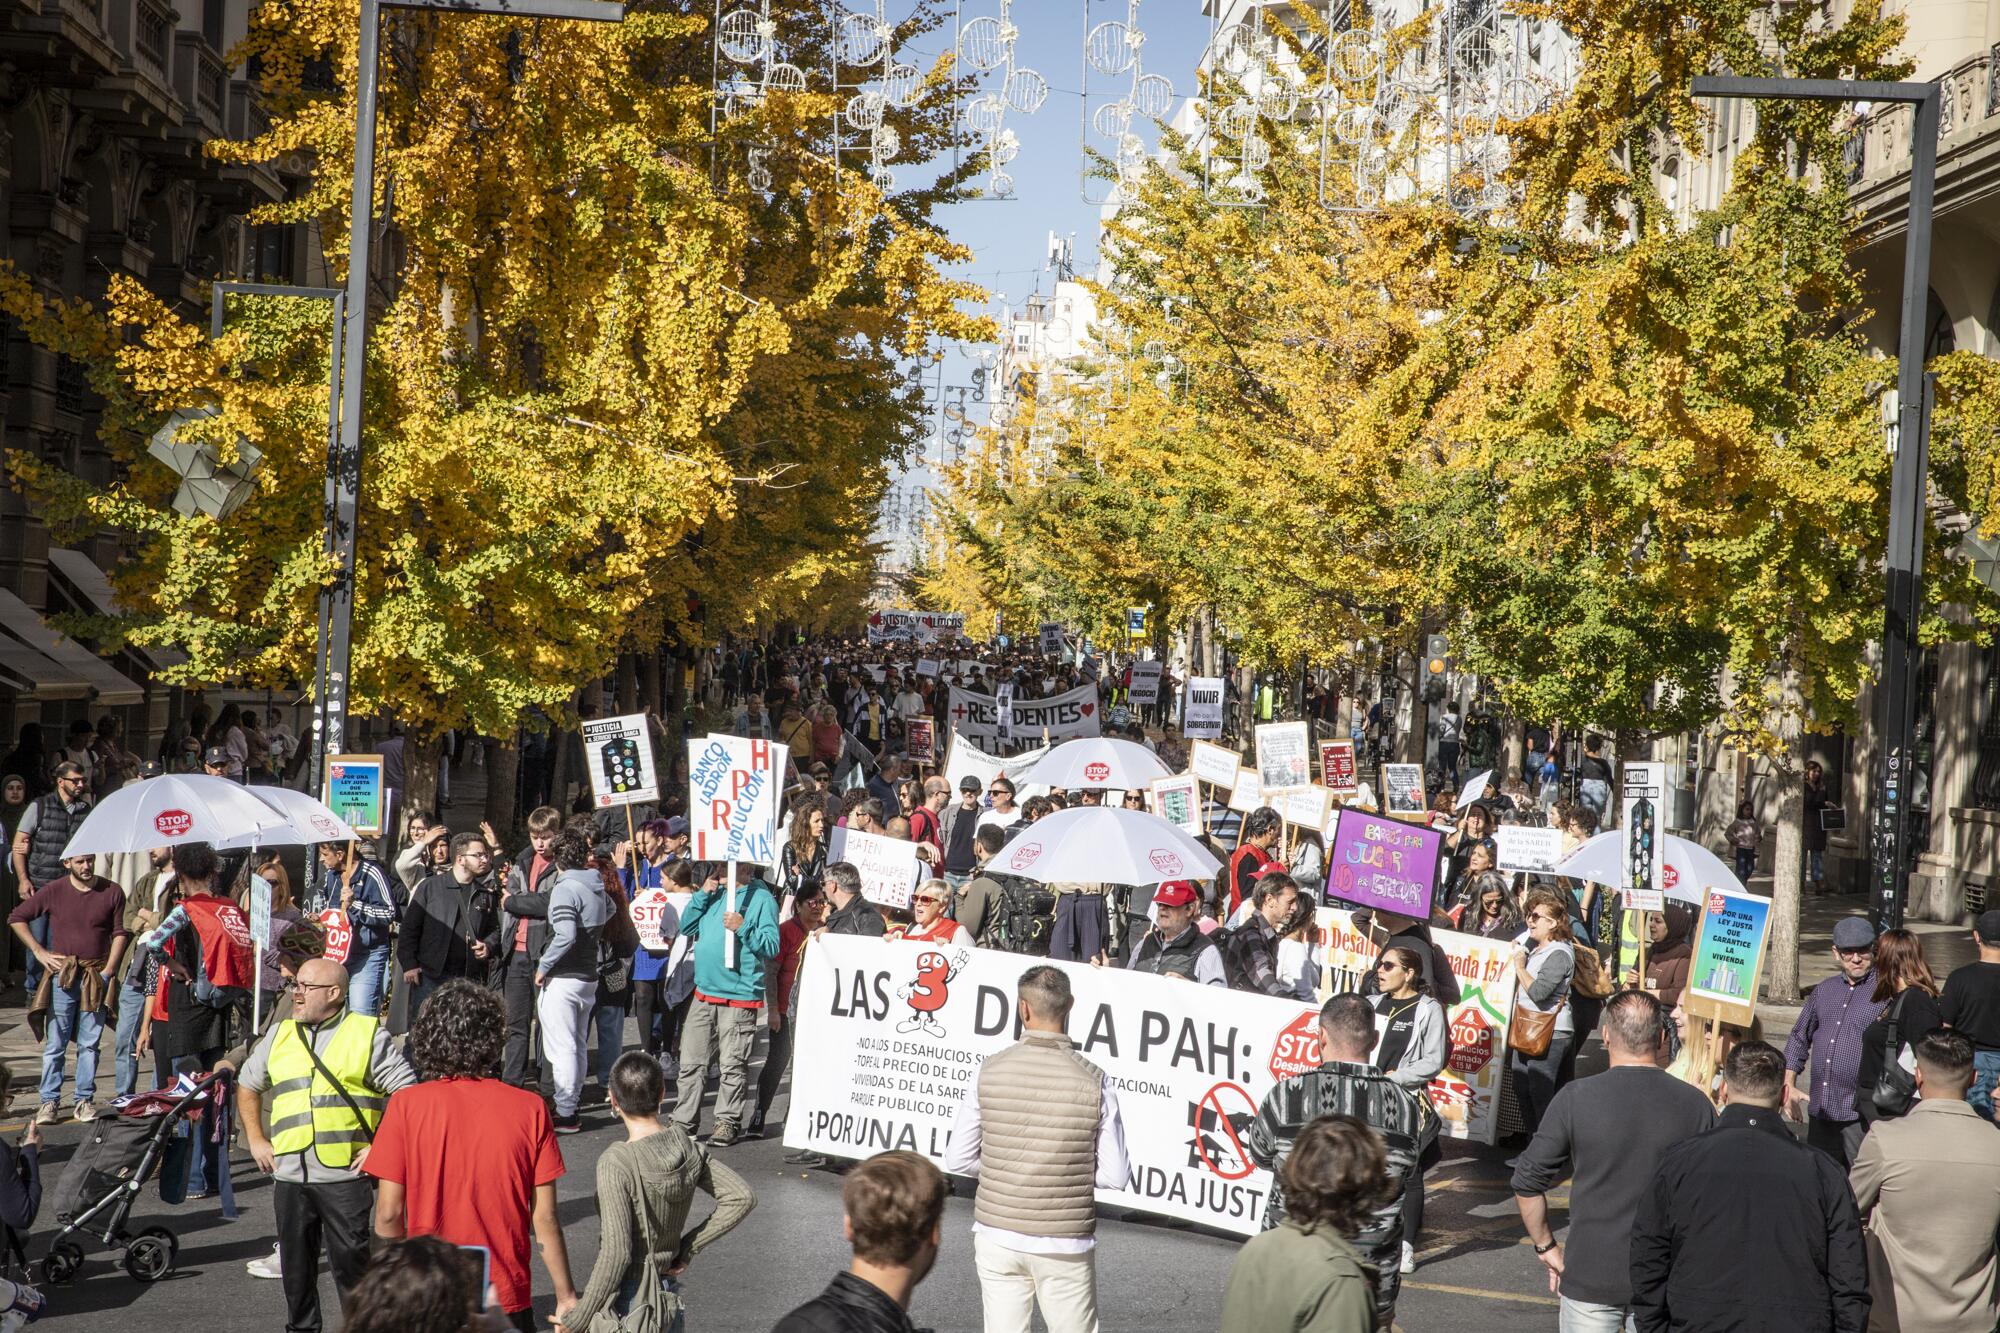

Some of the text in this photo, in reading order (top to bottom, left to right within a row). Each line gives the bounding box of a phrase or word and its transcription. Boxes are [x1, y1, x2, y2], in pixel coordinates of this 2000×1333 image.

[922, 615, 962, 628] PLÍTICOS
[1047, 630, 1054, 638] LA
[1130, 689, 1156, 698] NEGOCIO
[1192, 690, 1219, 704] VIVIR
[591, 721, 621, 734] JUSTICIA
[1186, 720, 1221, 729] SOBREVIVIR
[592, 733, 612, 742] SERVICIO
[623, 729, 639, 738] BANCA
[690, 741, 725, 786] BANCO
[1086, 766, 1109, 774] STOP
[1629, 769, 1648, 784] JUSTICIA
[159, 814, 189, 827] STOP
[1017, 847, 1040, 859] STOP
[1346, 841, 1403, 873] JUGAR
[1151, 854, 1178, 866] STOP
[1333, 864, 1354, 893] NO
[1709, 899, 1725, 907] STOP
[1721, 910, 1737, 918] POR
[1739, 913, 1753, 921] UNA
[1718, 918, 1753, 930] LEY JUSTA
[1727, 929, 1741, 937] QUE
[1713, 935, 1752, 948] GARANTICE
[1725, 946, 1734, 954] LA
[1712, 953, 1745, 965] VIVIENDA
[831, 968, 891, 1021] LAS
[1138, 1009, 1252, 1084] PAH:
[1450, 1024, 1490, 1046] STOP
[893, 1041, 972, 1064] DESAHUCIOS
[883, 1058, 930, 1075] PRECIO
[933, 1065, 948, 1078] DE
[951, 1067, 973, 1083] LOS
[1465, 1062, 1472, 1070] M
[852, 1073, 894, 1089] -VIVIENDAS
[898, 1079, 917, 1092] DE
[919, 1081, 934, 1096] LA
[850, 1092, 954, 1118] PARQUE PUBLICO DE
[808, 1110, 853, 1144] ¡POR
[854, 1116, 918, 1151] UNA
[1195, 1178, 1263, 1221] JUST
